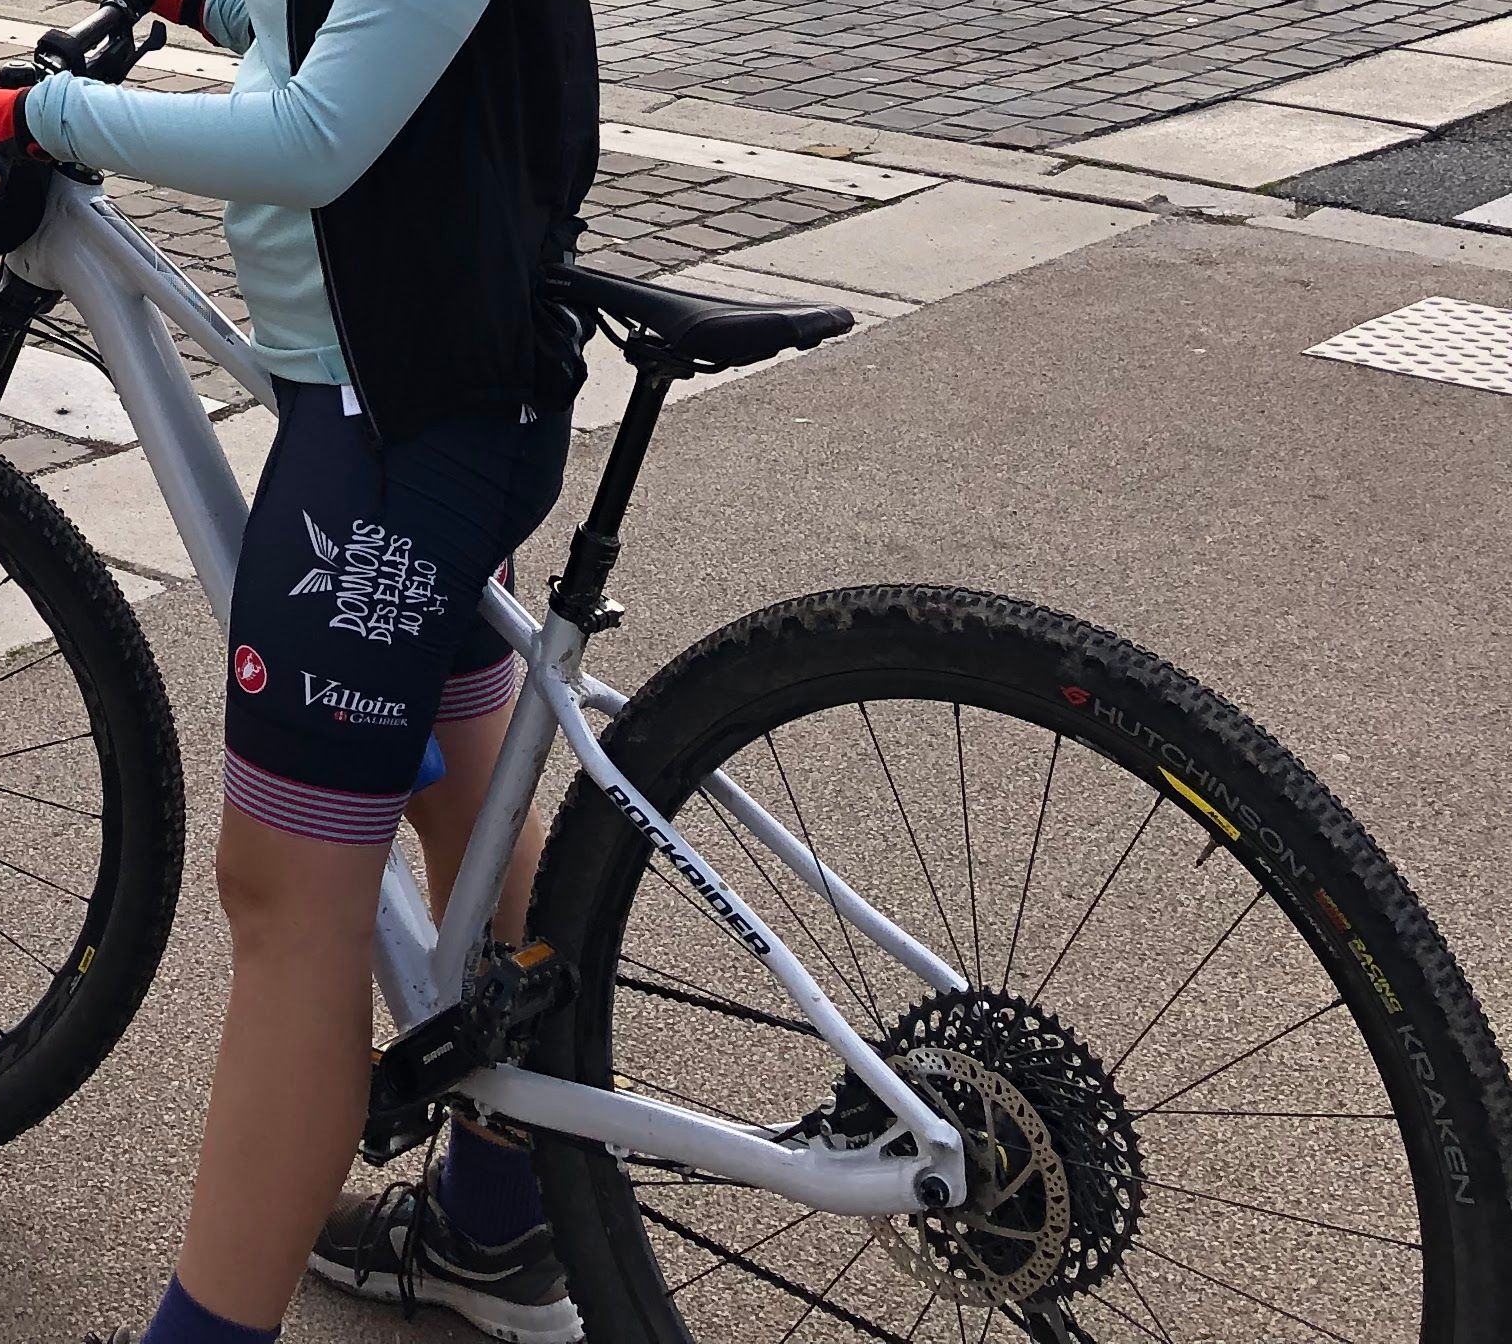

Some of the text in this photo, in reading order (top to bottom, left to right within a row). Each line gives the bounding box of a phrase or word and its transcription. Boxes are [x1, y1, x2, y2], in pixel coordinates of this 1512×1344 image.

[329, 519, 386, 637] DONNONS
[368, 534, 413, 645] DES ELLES
[398, 559, 437, 636] AU VÉLO
[300, 670, 406, 717] Valloire
[1093, 698, 1307, 879] HUTCHINSON
[605, 784, 771, 957] ROCKRIDER
[1352, 938, 1404, 1013] RACING
[1397, 1024, 1475, 1206] KRAKEN
